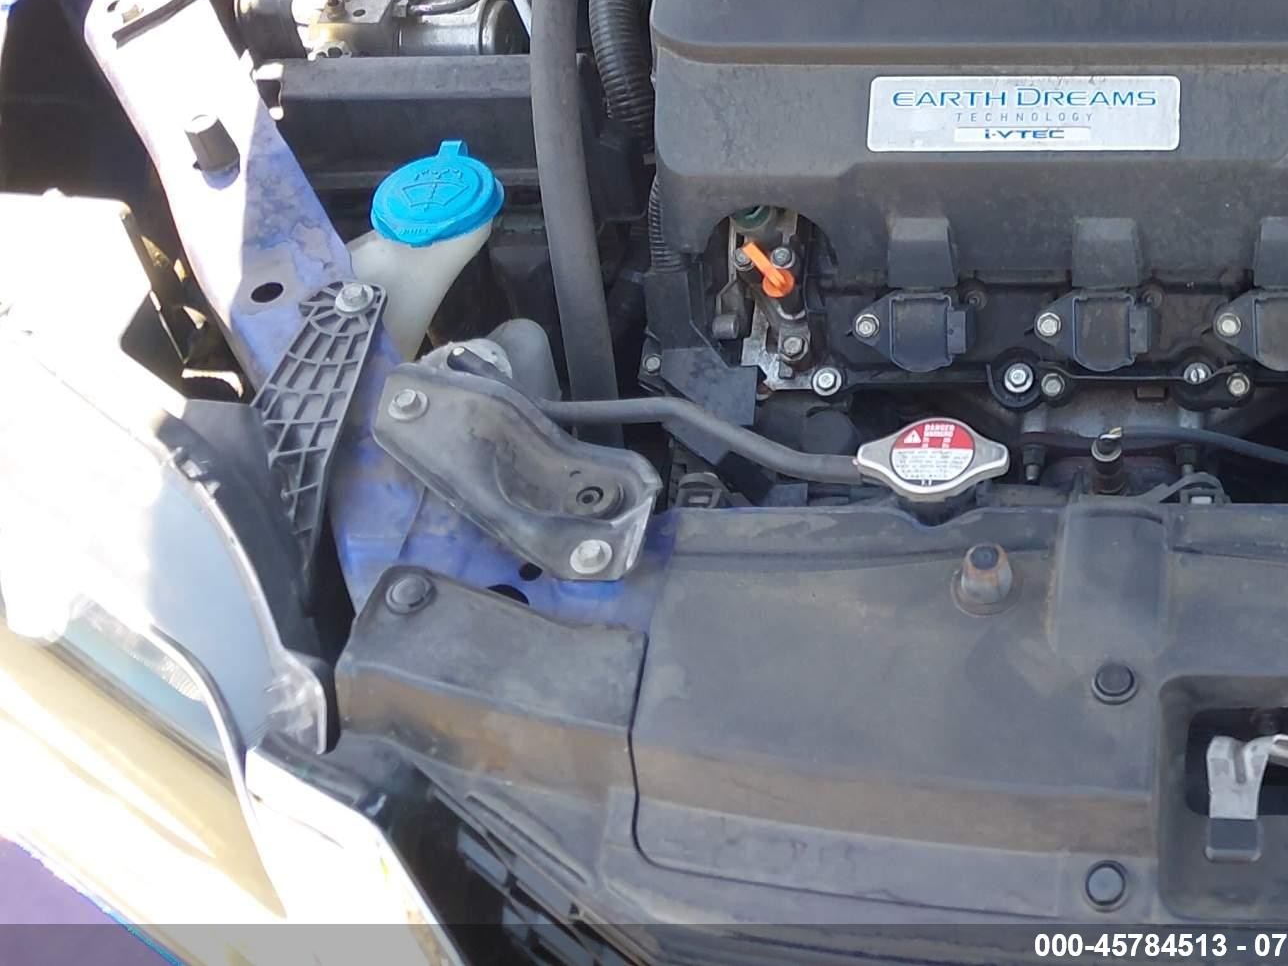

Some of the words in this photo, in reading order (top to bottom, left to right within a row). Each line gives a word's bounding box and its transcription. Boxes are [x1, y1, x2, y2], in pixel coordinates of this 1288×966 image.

[892, 90, 1006, 107] EARTH
[1017, 87, 1157, 107] DREAMS
[955, 112, 1094, 122] TECHNOLOGY
[983, 128, 1065, 140] i-VTEC
